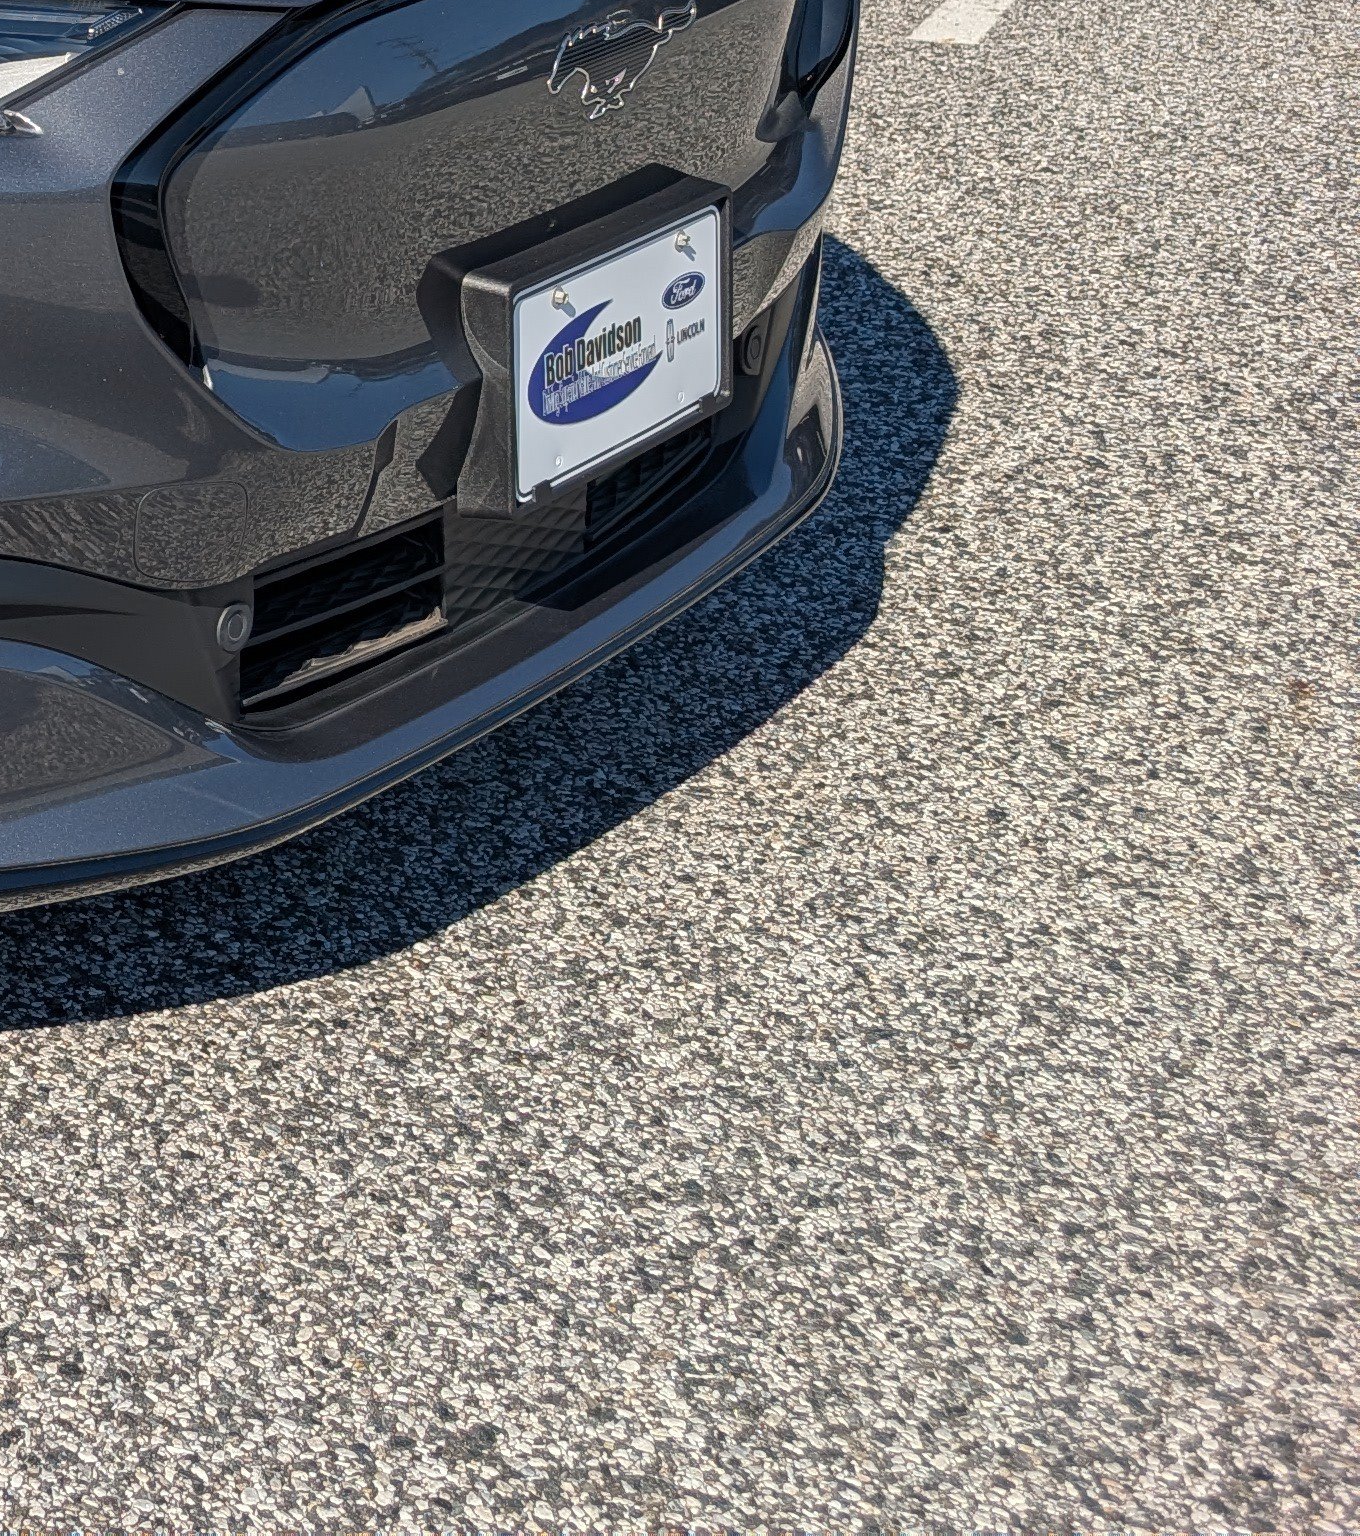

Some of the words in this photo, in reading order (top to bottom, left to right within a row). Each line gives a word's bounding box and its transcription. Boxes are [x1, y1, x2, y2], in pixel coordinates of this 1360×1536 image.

[545, 345, 574, 388] Bob
[575, 316, 642, 372] Davidson
[676, 318, 705, 345] LINCOLN
